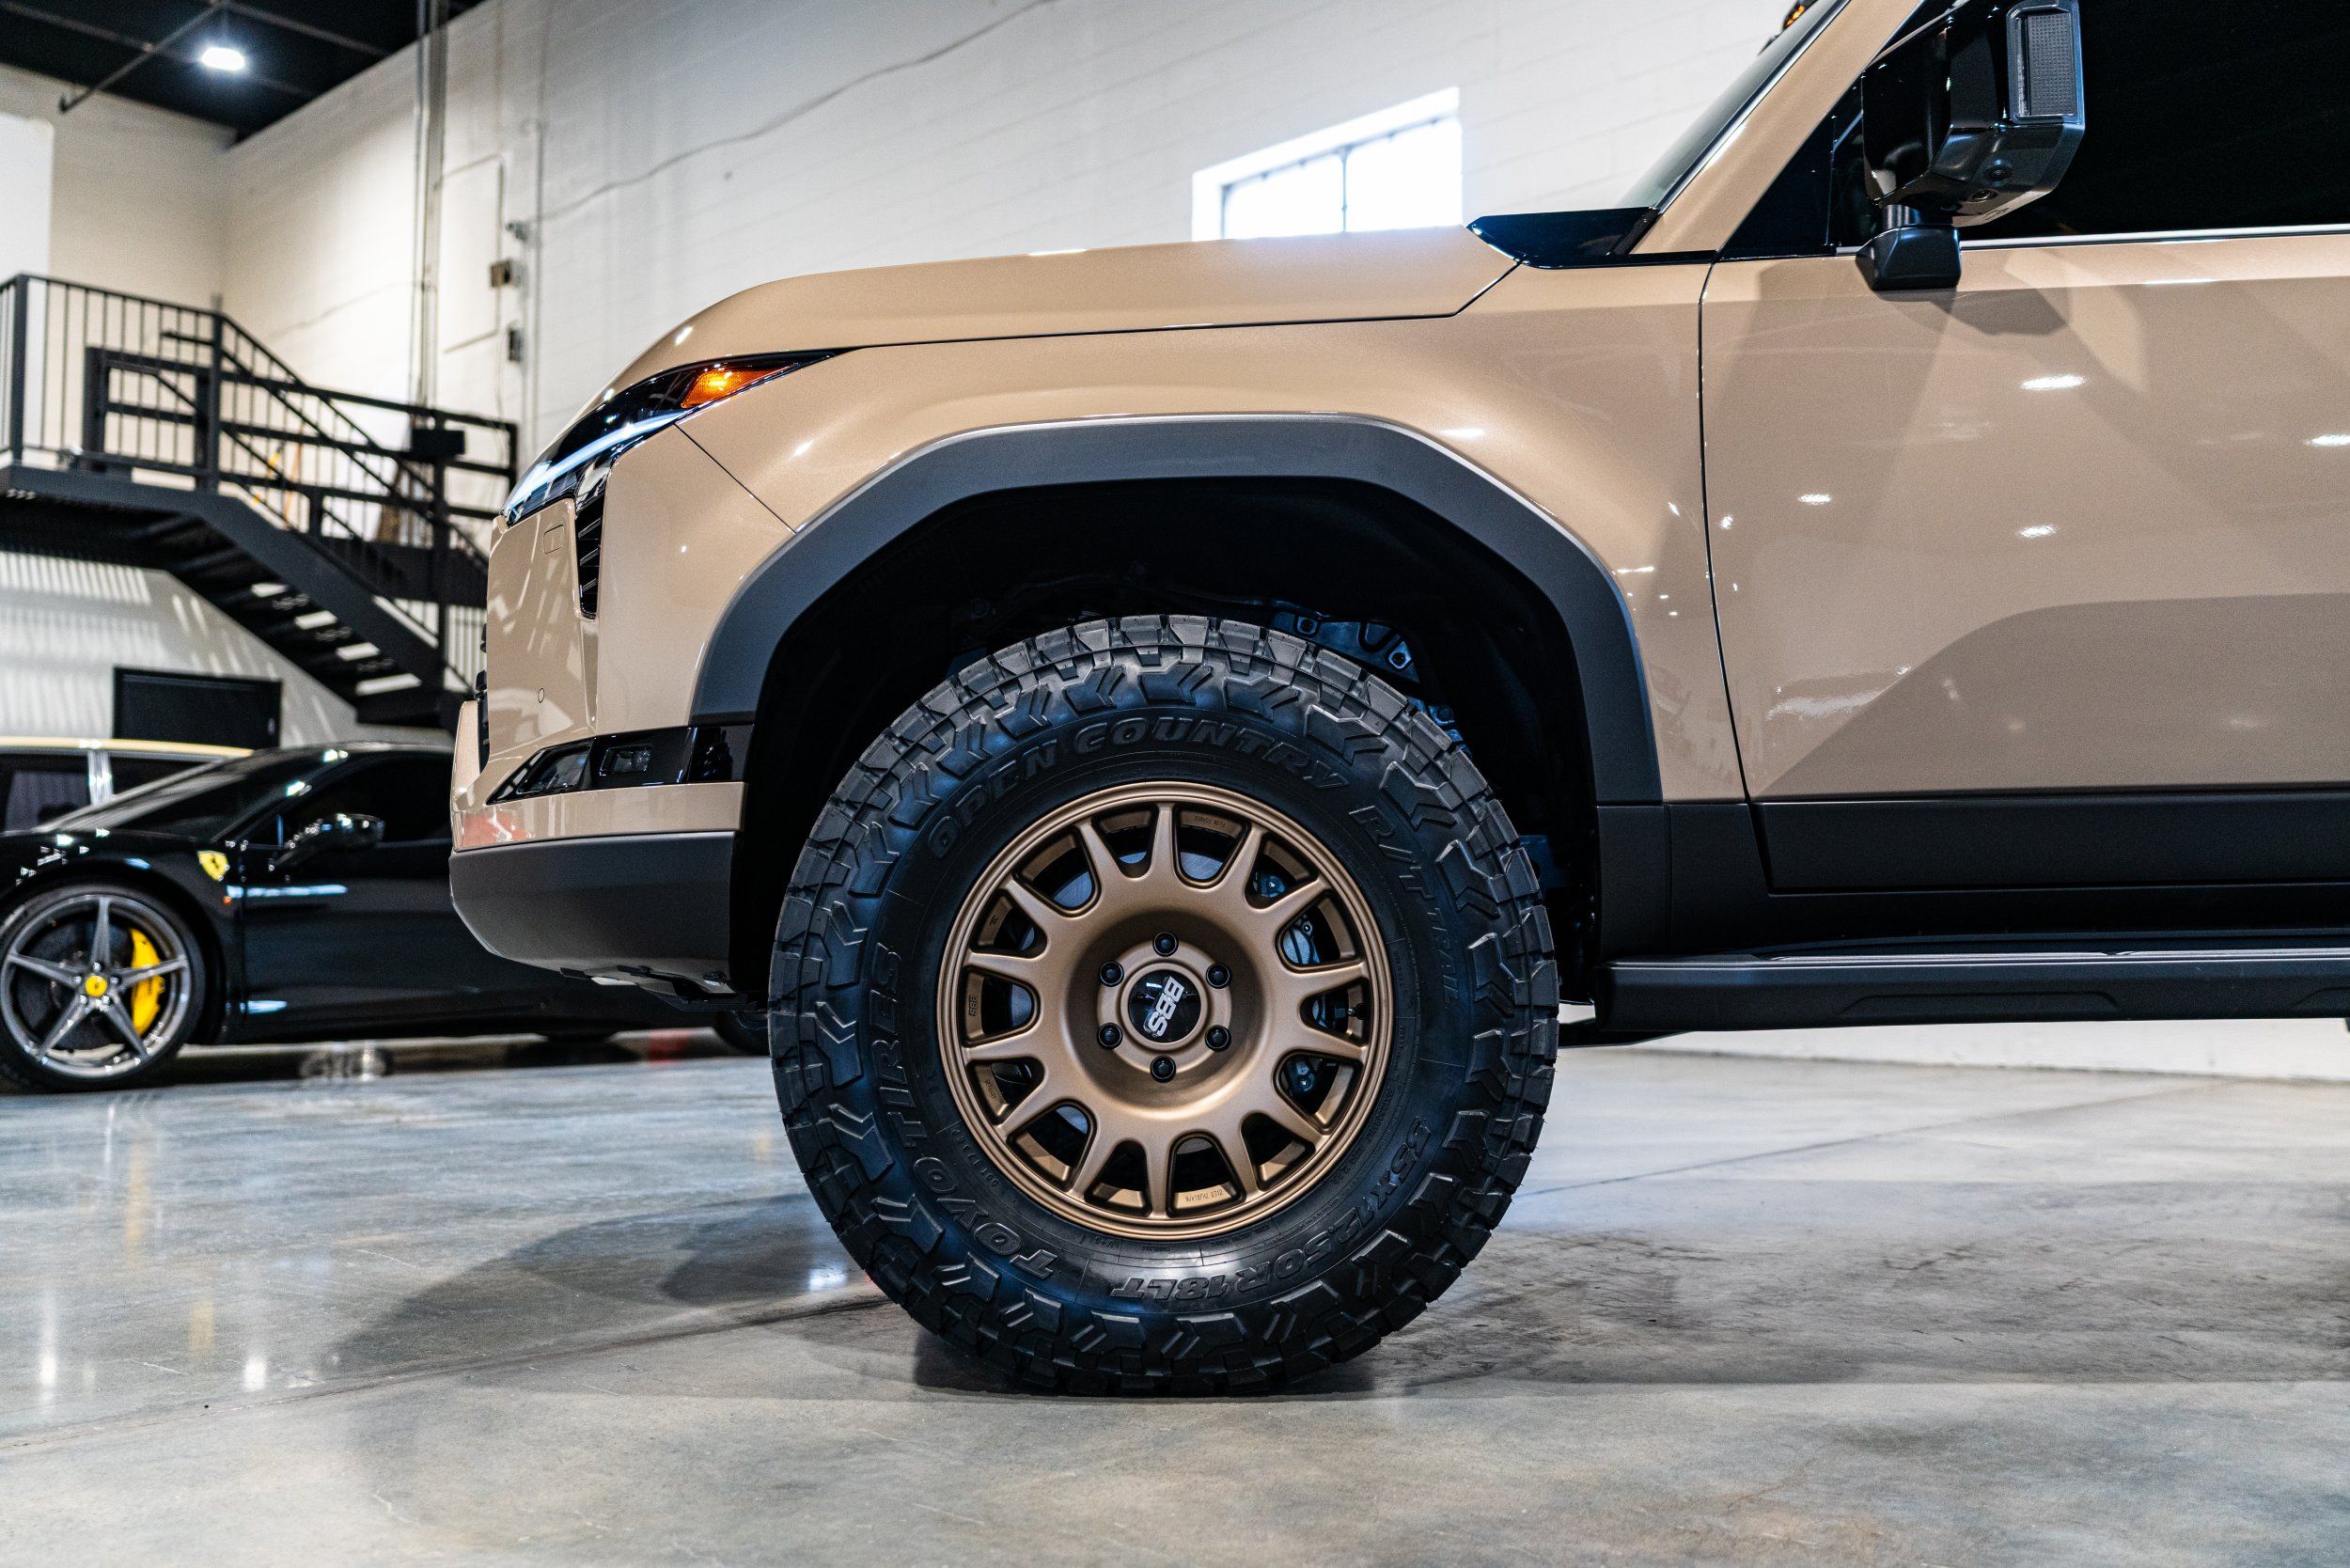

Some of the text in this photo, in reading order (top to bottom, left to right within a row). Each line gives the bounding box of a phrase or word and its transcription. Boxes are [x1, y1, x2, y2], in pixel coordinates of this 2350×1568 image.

[927, 739, 1059, 858] OPEN
[1074, 715, 1349, 791] COUNTRY
[1349, 805, 1434, 900] R/T
[1143, 976, 1184, 1037] BBS
[871, 942, 1058, 1279] TOYO TIRES
